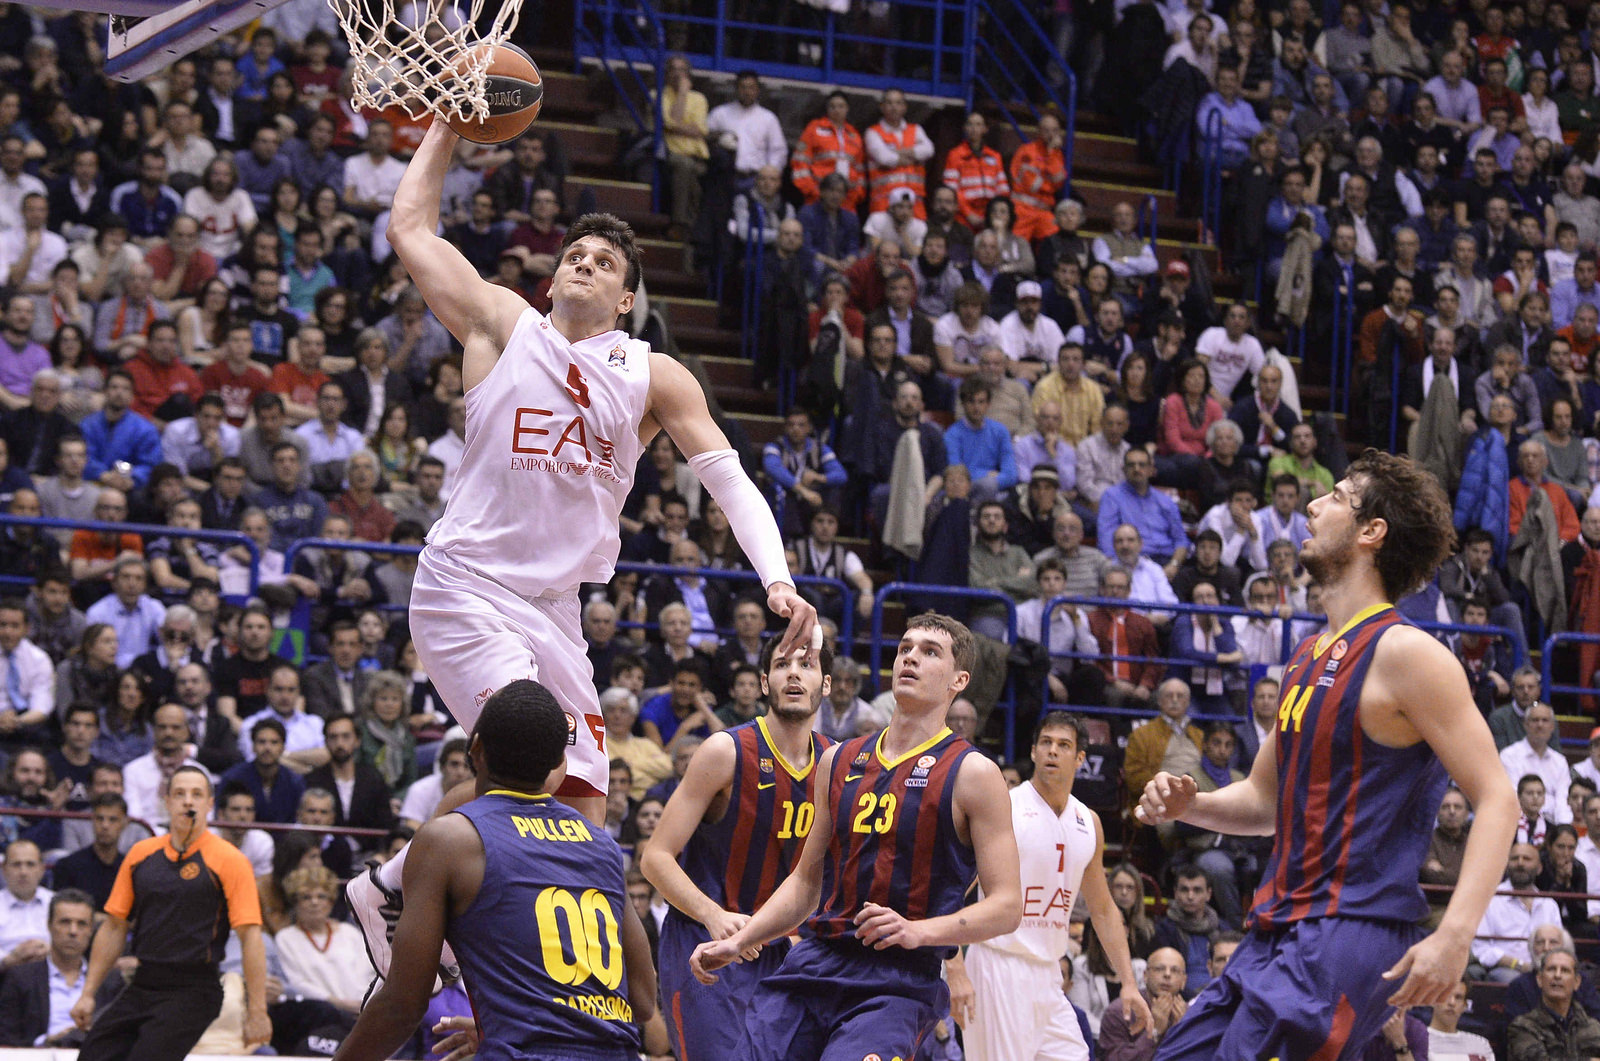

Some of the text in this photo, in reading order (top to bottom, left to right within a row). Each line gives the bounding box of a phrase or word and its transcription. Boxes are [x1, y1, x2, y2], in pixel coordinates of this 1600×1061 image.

[565, 363, 590, 408] 5
[510, 457, 570, 475] EMPORIO
[1278, 685, 1315, 732] 44
[511, 816, 593, 842] PULLEN
[777, 801, 815, 839] 10
[852, 792, 898, 834] 23
[1056, 843, 1065, 873] 7
[535, 886, 623, 991] 00
